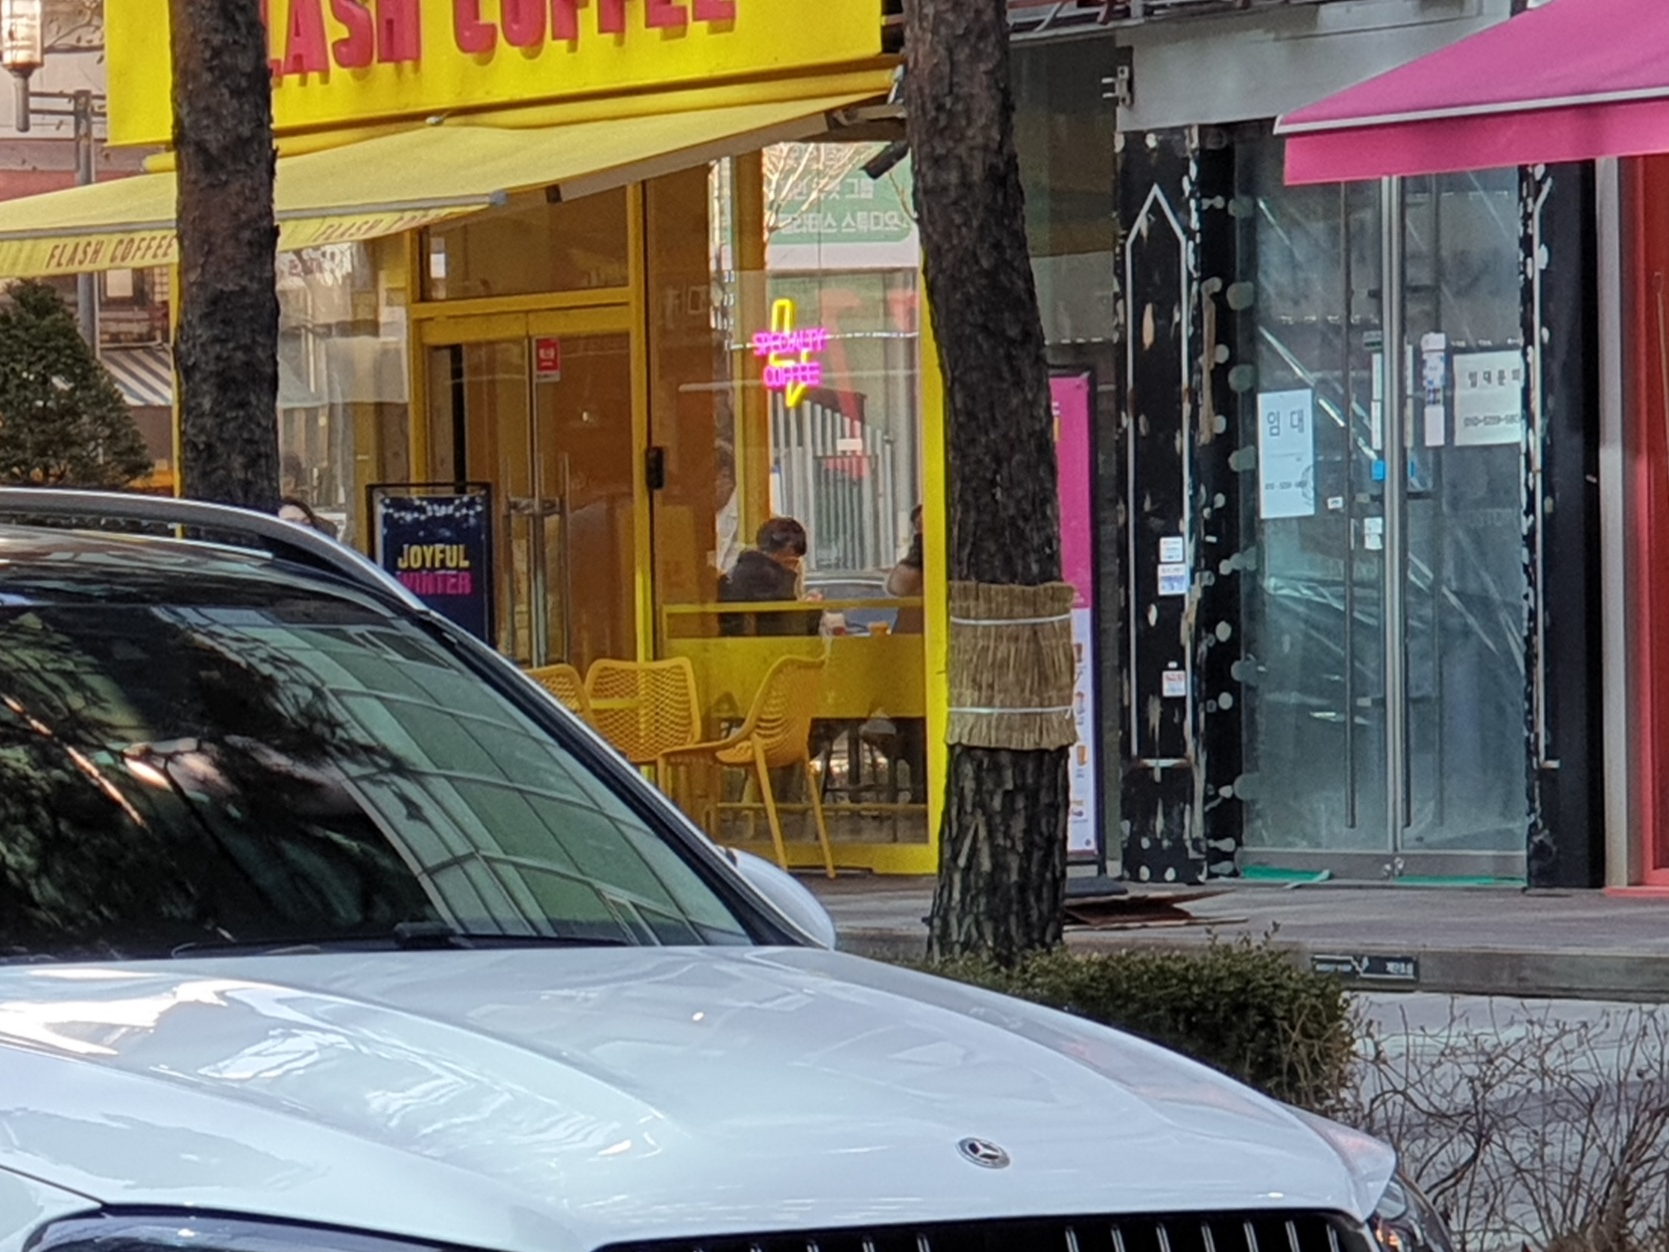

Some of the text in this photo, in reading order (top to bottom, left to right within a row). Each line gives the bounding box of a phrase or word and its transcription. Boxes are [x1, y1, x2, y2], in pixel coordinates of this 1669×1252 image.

[841, 210, 903, 233] 스튜디오
[45, 234, 175, 270] FLASH COFFEE
[1266, 408, 1305, 437] 임대
[397, 544, 470, 569] JOYFUL
